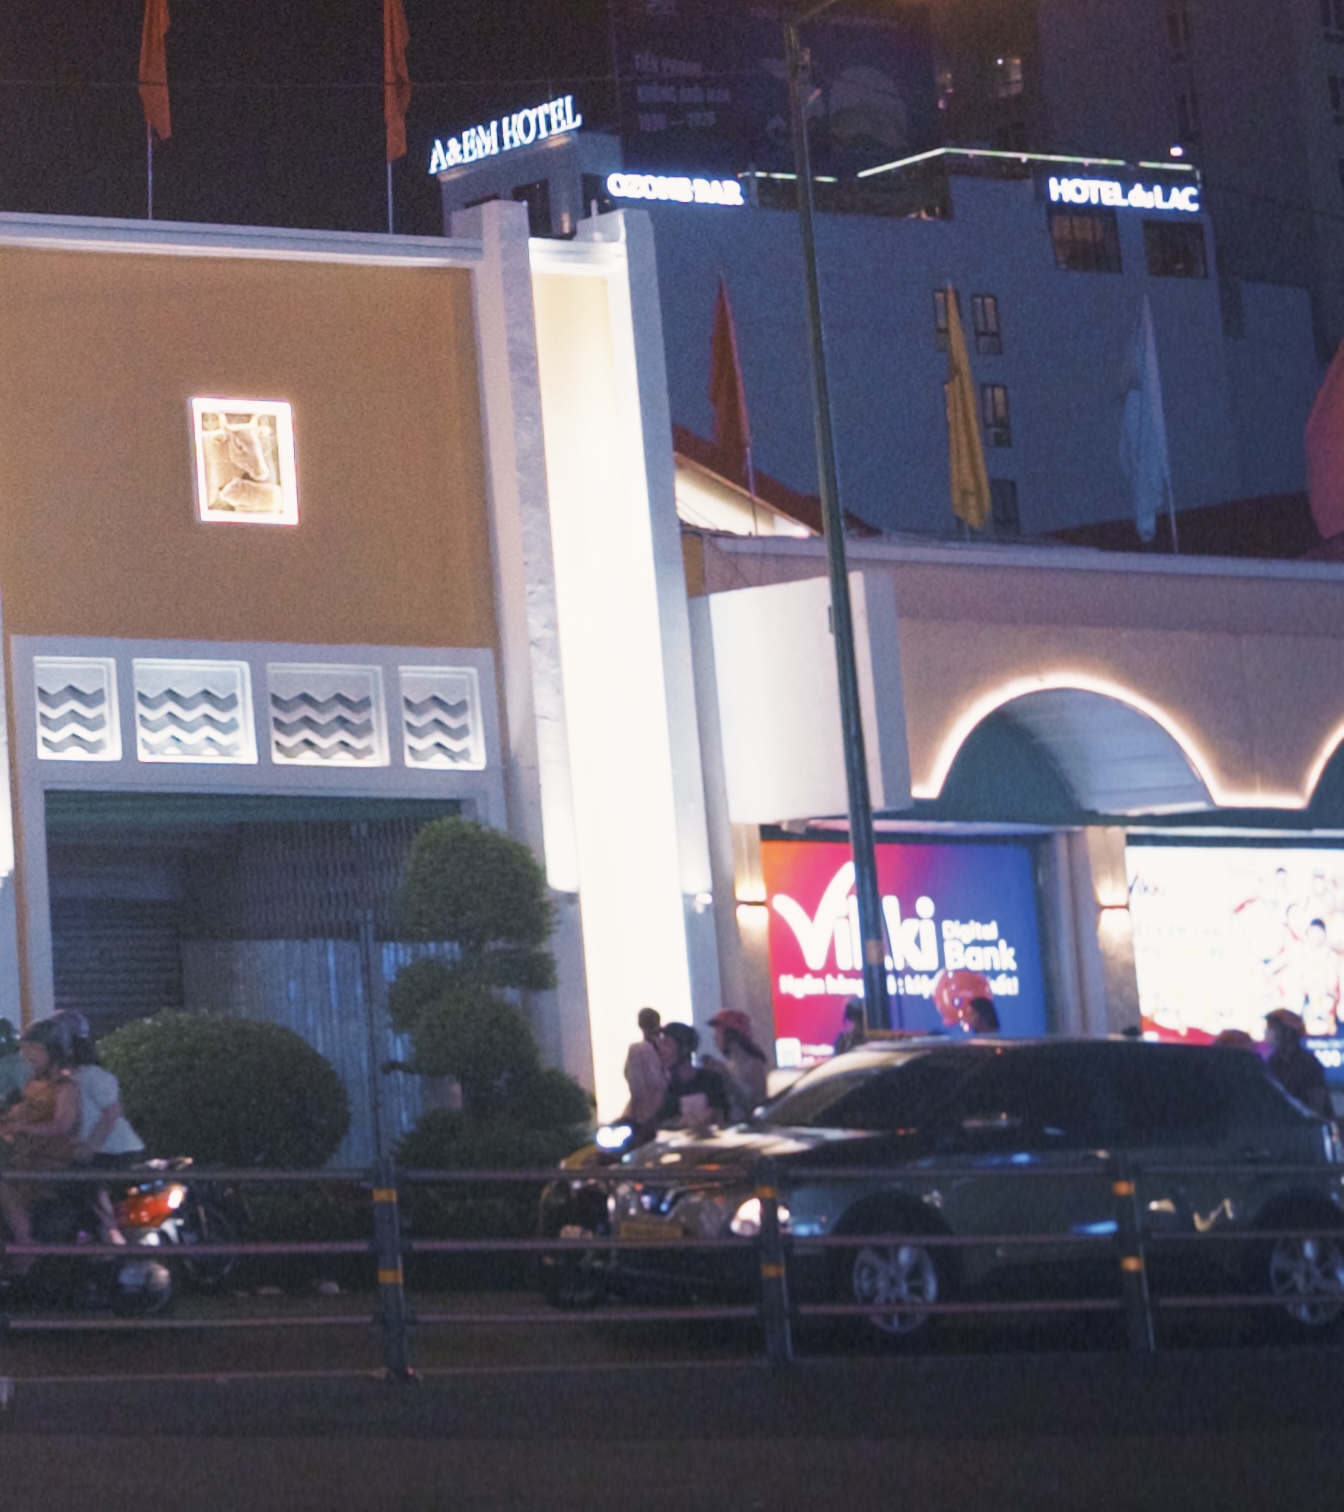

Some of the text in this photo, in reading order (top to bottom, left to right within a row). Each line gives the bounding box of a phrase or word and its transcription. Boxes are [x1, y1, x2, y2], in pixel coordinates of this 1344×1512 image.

[502, 95, 582, 151] HOTEL
[1049, 177, 1129, 206] HOTEL
[1154, 185, 1200, 211] LAC
[942, 920, 998, 944] Digital
[944, 938, 1017, 971] Bank
